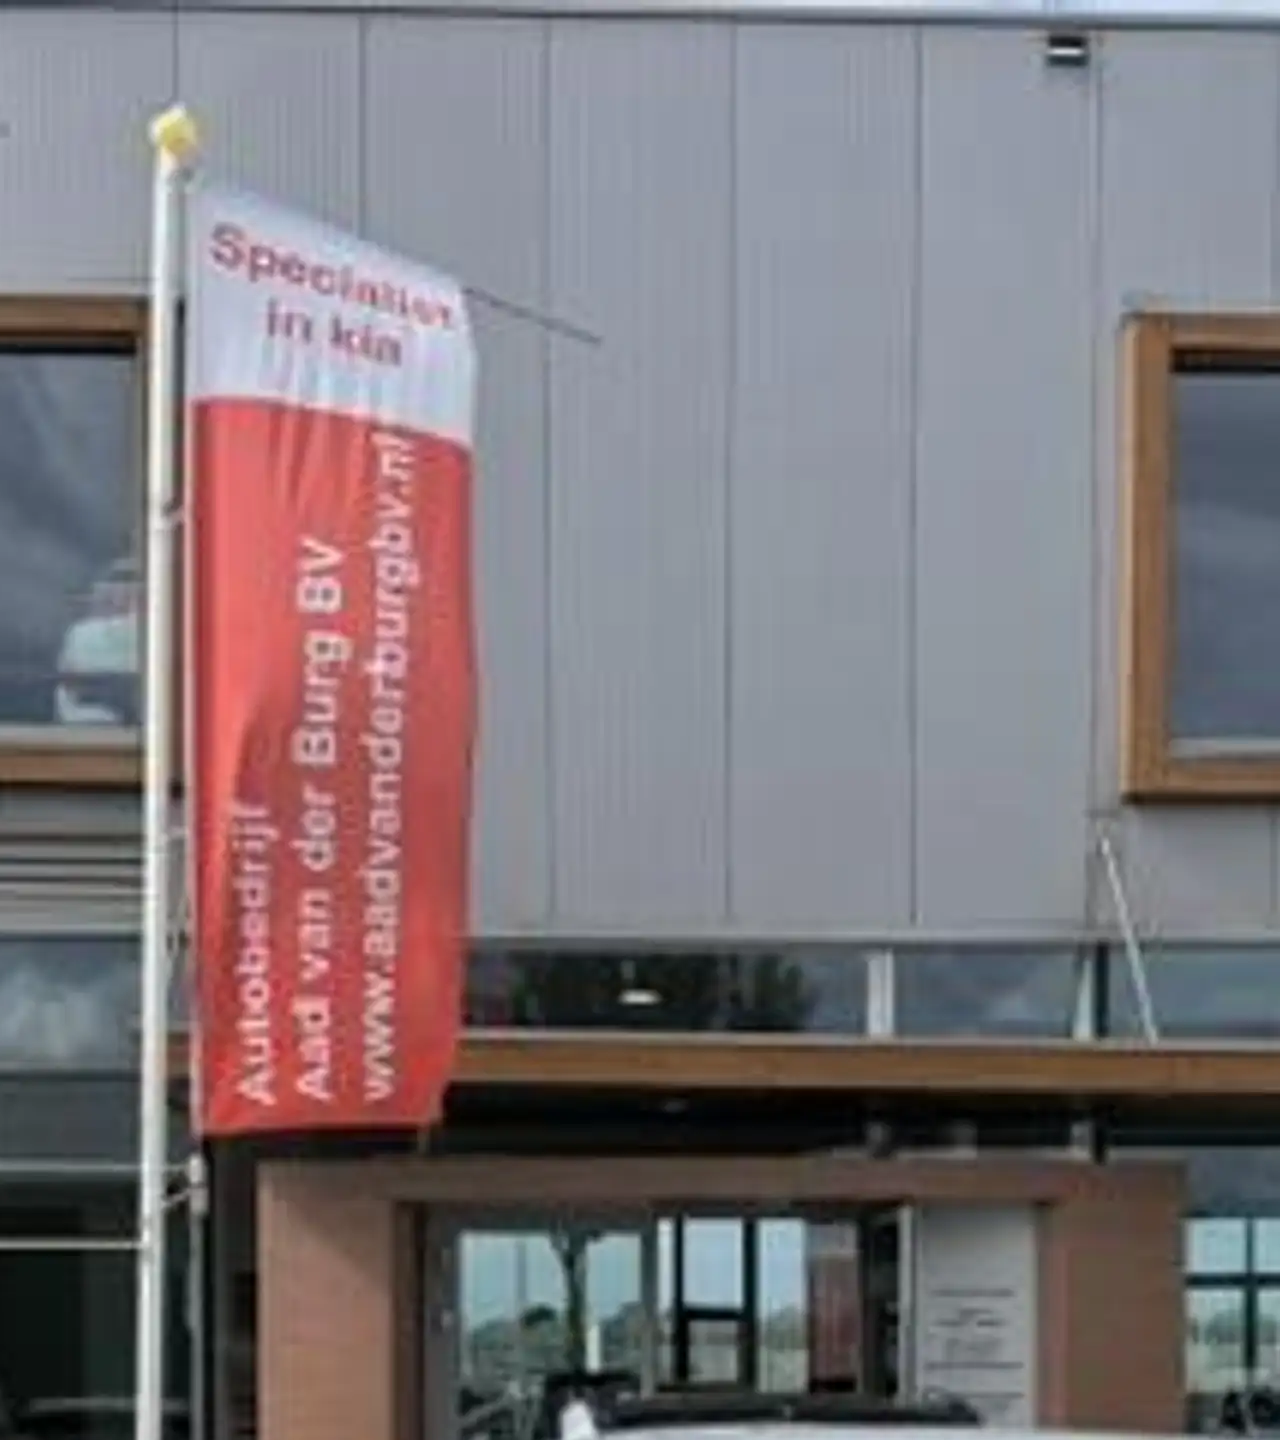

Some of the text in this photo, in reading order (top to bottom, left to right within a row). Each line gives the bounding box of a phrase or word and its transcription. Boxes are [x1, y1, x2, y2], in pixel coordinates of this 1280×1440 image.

[210, 223, 453, 329] Specialist
[265, 298, 313, 345] in
[289, 533, 352, 1102] Aad van der Burg BV
[355, 432, 421, 1103] www.aadvanderburgbv.nl
[232, 800, 280, 1106] Autobedrijf
